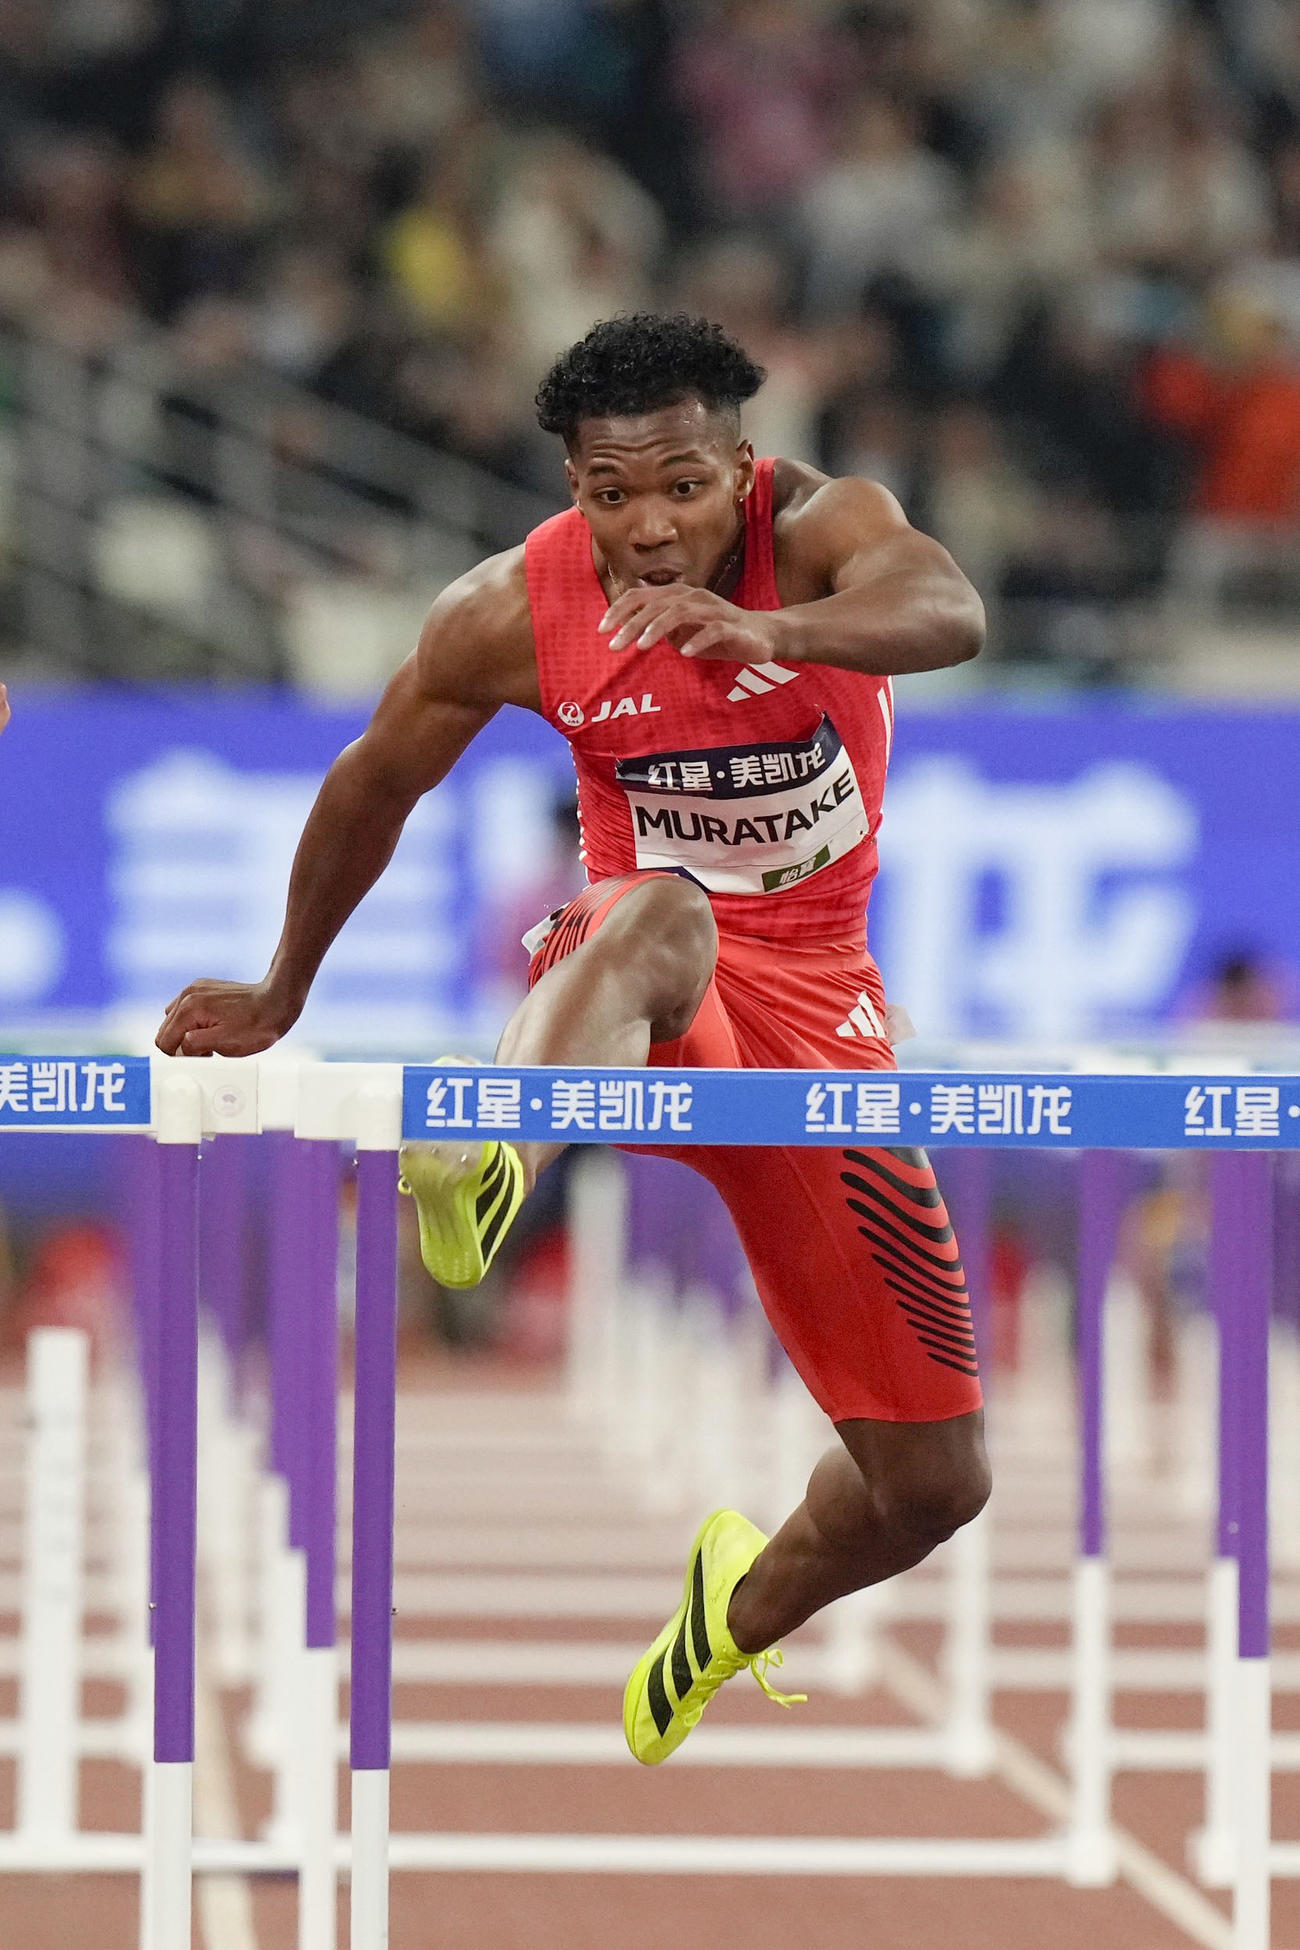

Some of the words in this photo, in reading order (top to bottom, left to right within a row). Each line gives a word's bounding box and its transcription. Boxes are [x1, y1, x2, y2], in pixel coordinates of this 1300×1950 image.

[591, 693, 661, 722] JAL
[635, 769, 855, 845] MURATAKE
[0, 1062, 125, 1112] 美凯龙
[426, 1078, 693, 1131] 红星·美凯龙
[806, 1083, 1072, 1135] 红星·美凯龙
